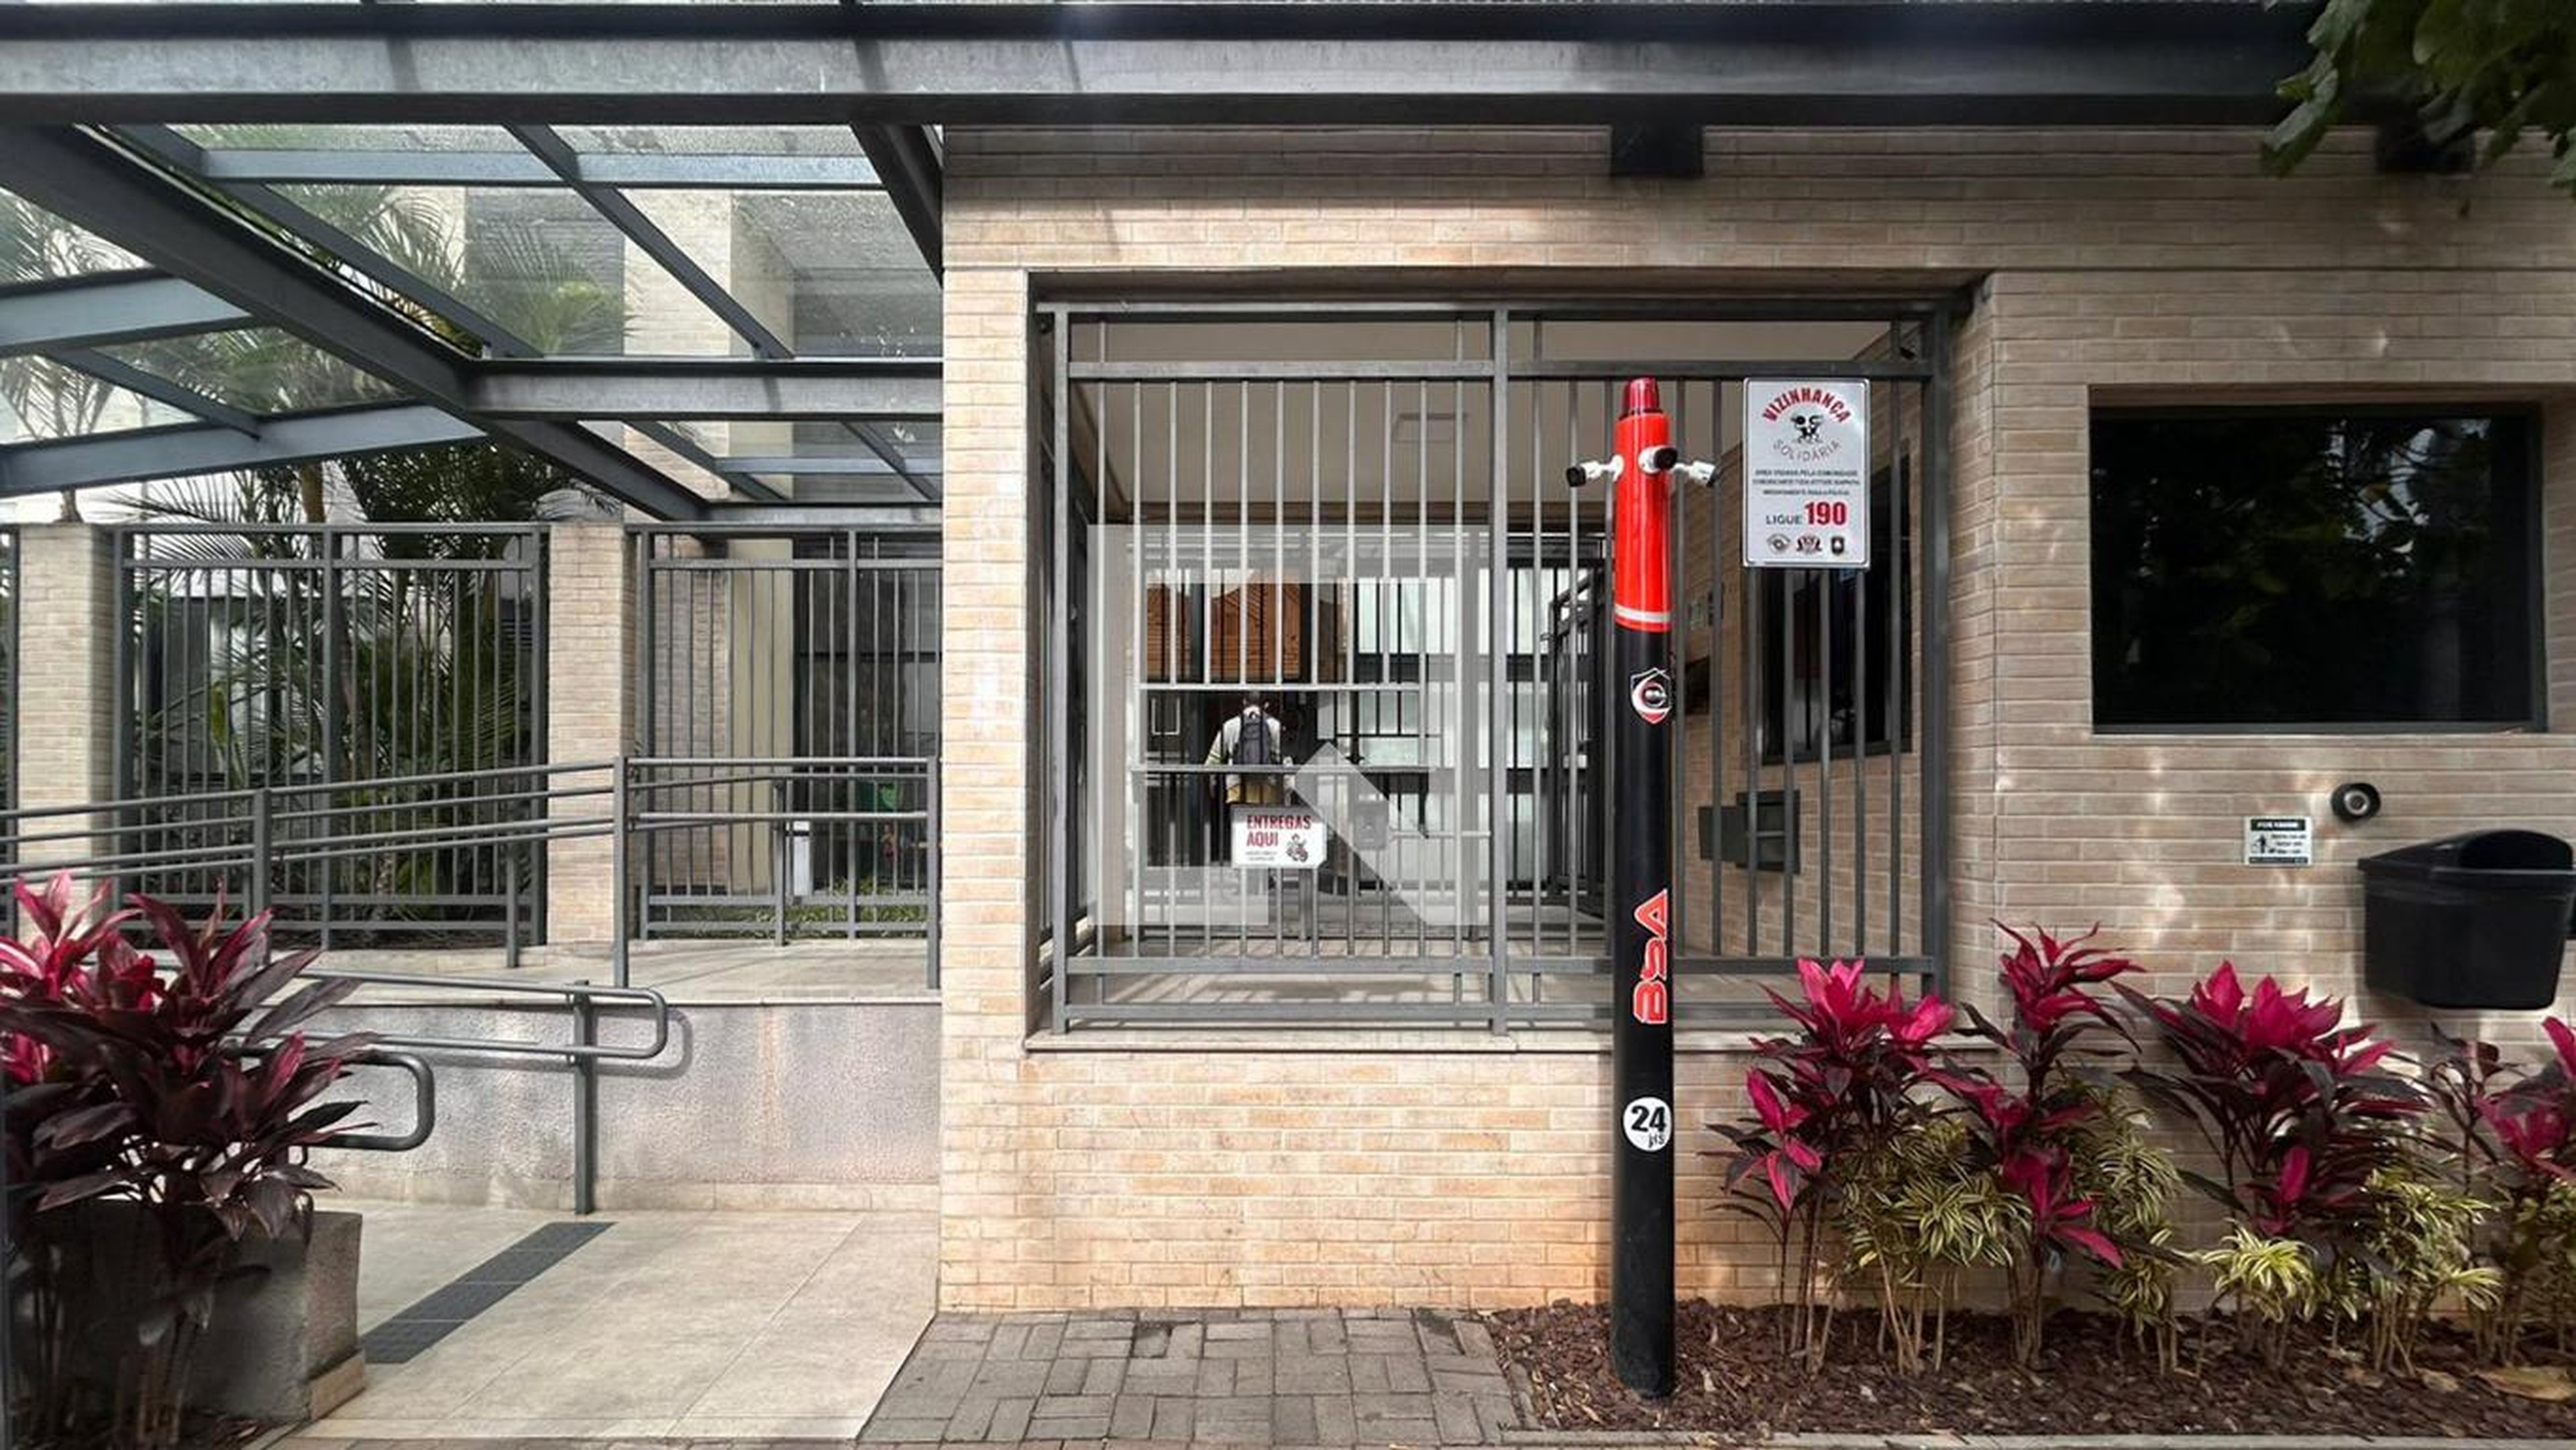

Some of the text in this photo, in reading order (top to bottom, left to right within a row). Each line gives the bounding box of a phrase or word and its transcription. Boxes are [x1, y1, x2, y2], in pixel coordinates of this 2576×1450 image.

[1762, 387, 1851, 423] VIZINHANÇA
[1766, 501, 1847, 525] LIGUE 190
[1246, 815, 1311, 830] ENTREGAS
[1246, 831, 1279, 847] AQUI
[1633, 888, 1668, 1025] BSA
[1631, 1104, 1666, 1132] 24
